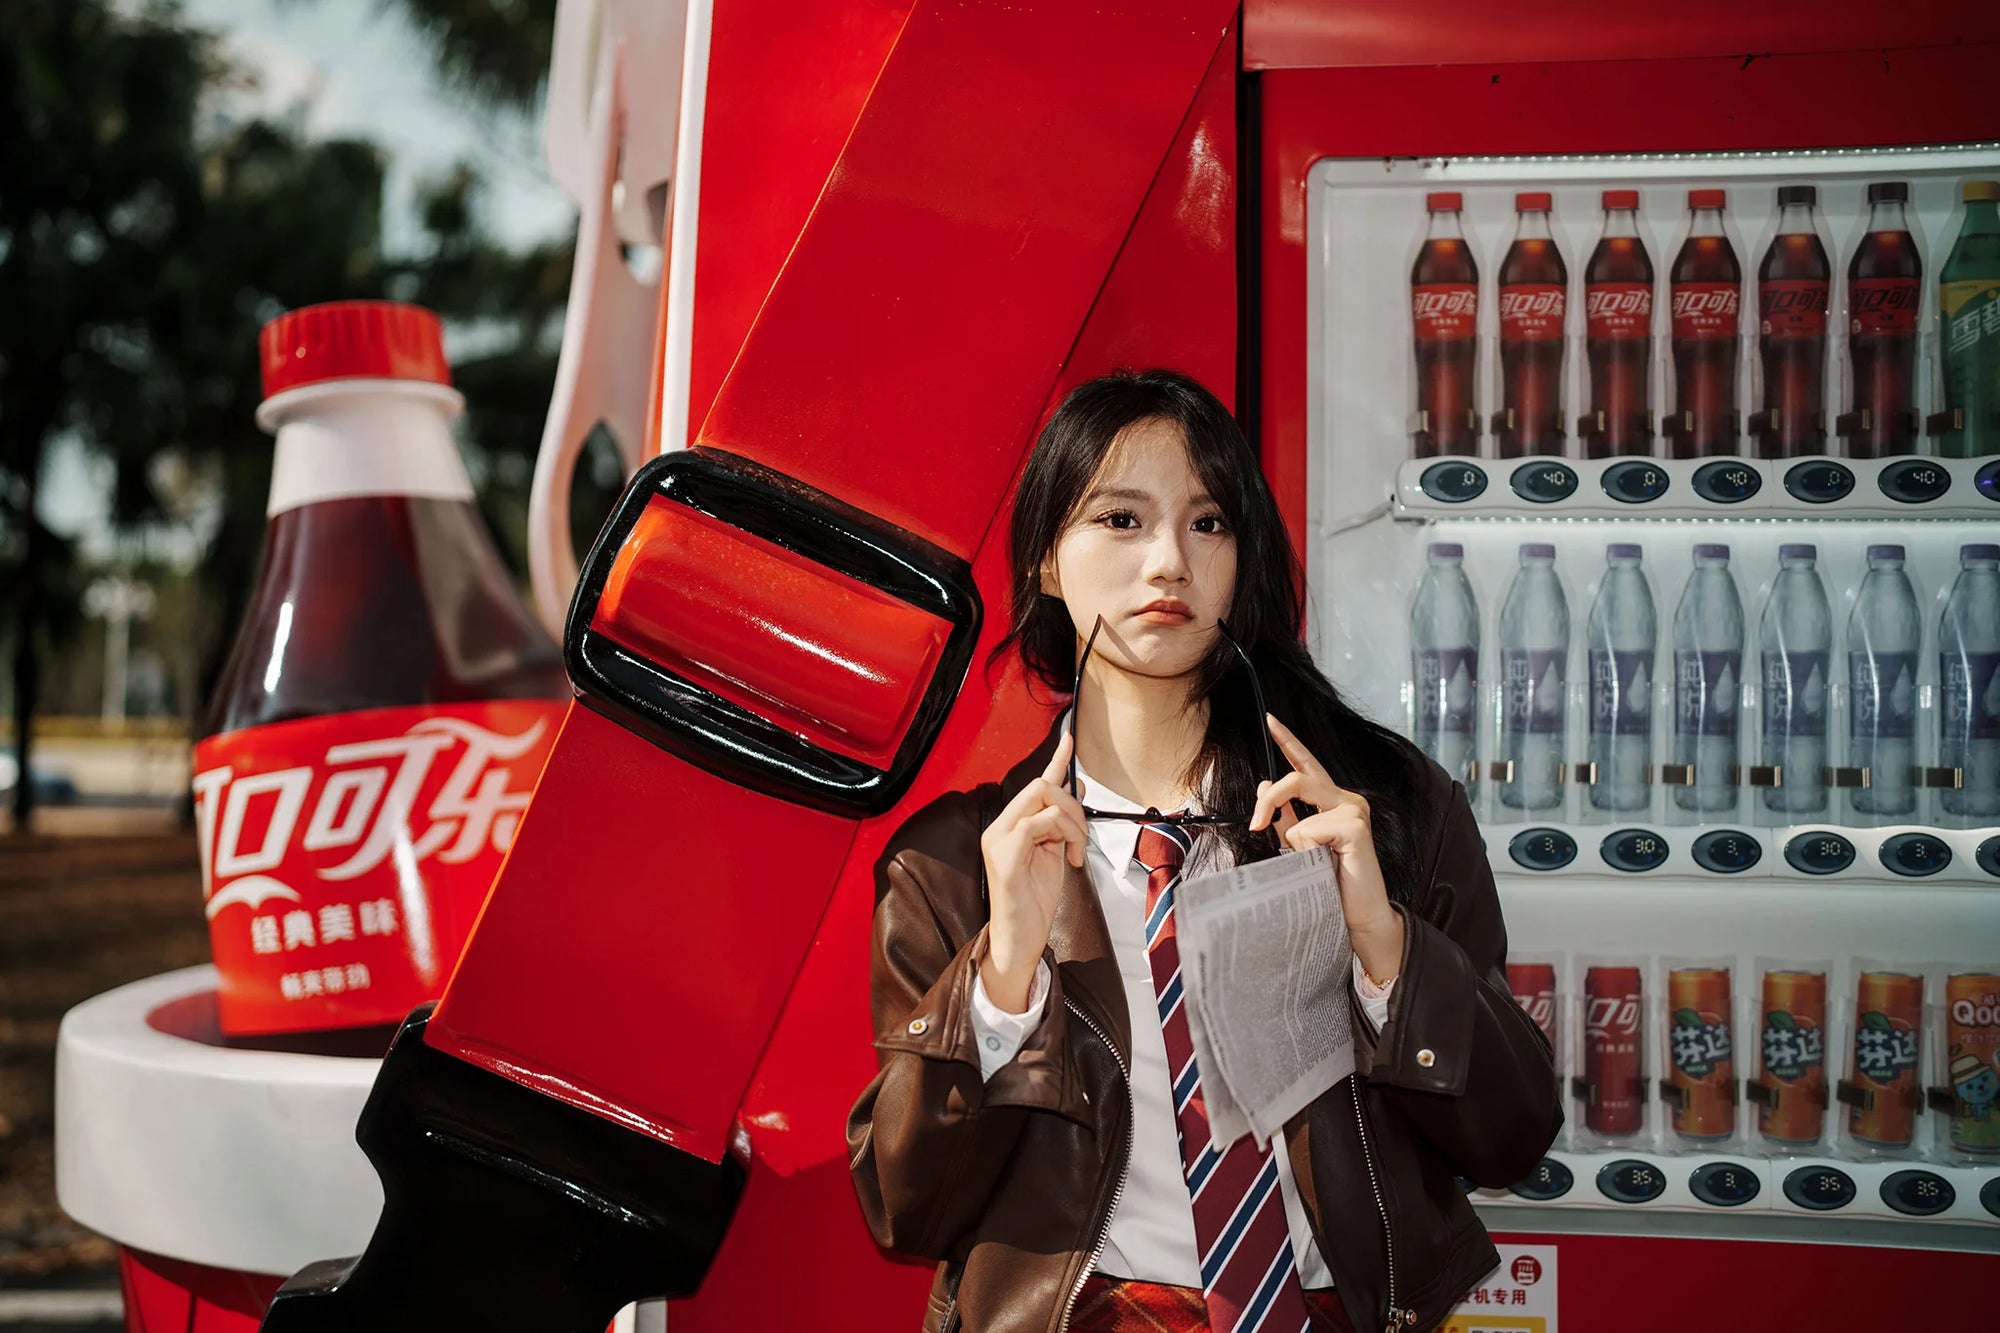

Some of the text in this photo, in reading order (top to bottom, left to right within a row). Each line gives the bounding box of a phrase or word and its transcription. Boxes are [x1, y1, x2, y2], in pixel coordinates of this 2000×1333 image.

[1414, 289, 1477, 316] 可口可乐
[1501, 290, 1565, 317] 可口可乐
[1588, 289, 1651, 315] 可口可乐
[1673, 288, 1739, 315] 可口可乐
[251, 898, 398, 954] 经典美味
[1672, 1022, 1731, 1066] 芬达
[1763, 1027, 1822, 1067] 芬达
[1857, 1028, 1918, 1068] 芬达
